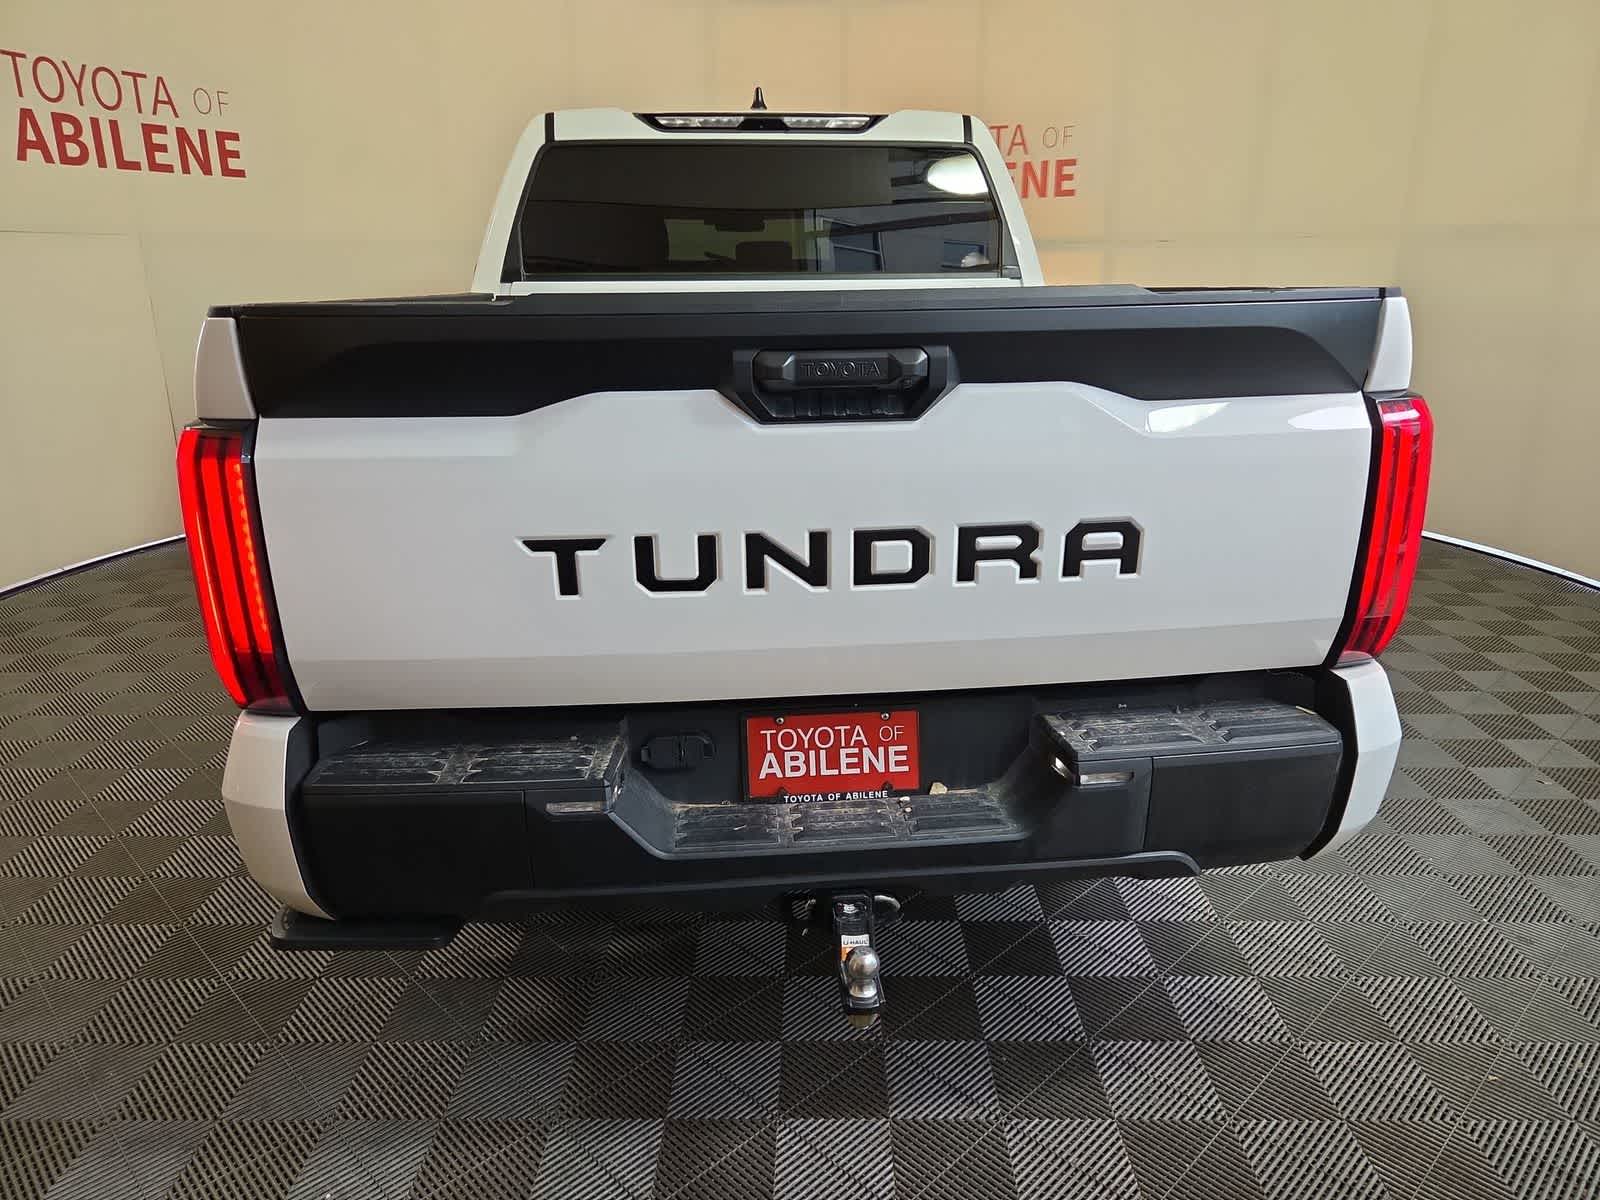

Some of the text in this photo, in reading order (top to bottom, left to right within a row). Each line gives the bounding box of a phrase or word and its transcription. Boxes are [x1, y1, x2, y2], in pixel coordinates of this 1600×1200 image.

[0, 49, 229, 119] TOYOTA OF
[16, 107, 247, 178] ABILENE
[1042, 125, 1076, 149] OF
[801, 360, 881, 377] TOYOTA
[515, 514, 1146, 600] TUNDRA
[760, 725, 905, 751] TOYOTA OF
[759, 745, 910, 779] ABILENE
[783, 790, 888, 803] TOYOTA OF ABILENE
